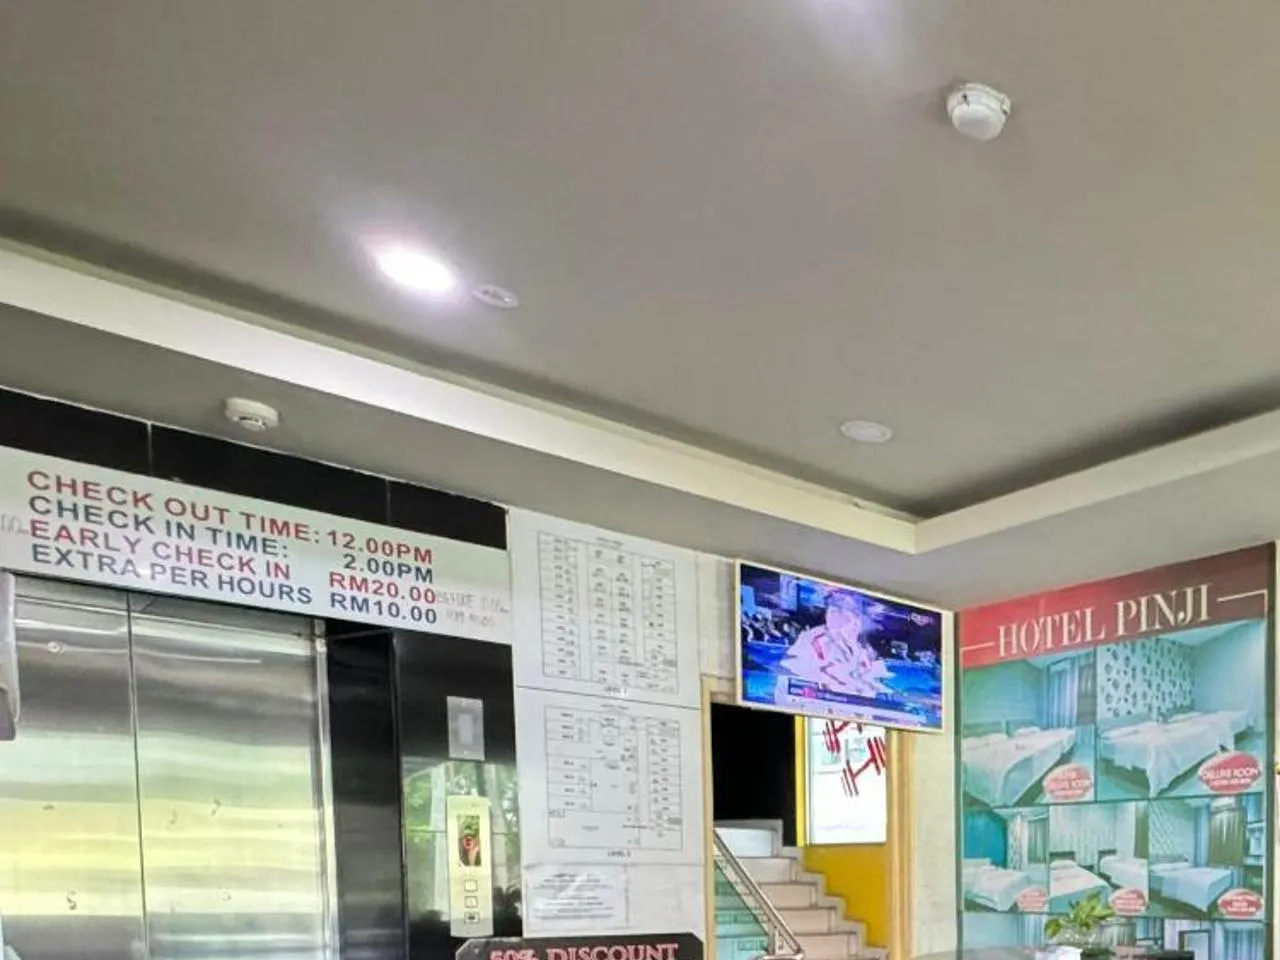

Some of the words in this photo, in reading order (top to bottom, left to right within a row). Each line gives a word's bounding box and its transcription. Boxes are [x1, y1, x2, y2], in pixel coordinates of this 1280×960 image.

[27, 470, 154, 512] CHECK
[164, 497, 230, 525] OUT
[240, 511, 320, 544] TIME:
[327, 529, 433, 566] 12.00PM
[29, 495, 156, 535] CHECK
[166, 519, 195, 542] IN
[205, 526, 288, 559] TIME:
[343, 553, 433, 584] 2.00PM
[30, 519, 142, 554] EARLY
[152, 541, 256, 575] CHECK
[266, 559, 291, 580] IN
[329, 571, 436, 605] RM20.00
[32, 543, 141, 578] EXTRA
[150, 562, 209, 589] PER
[217, 574, 312, 605] HOURS
[330, 592, 437, 625] RM10.00
[997, 606, 1105, 658] HOTEL
[1115, 582, 1213, 637] PINJI
